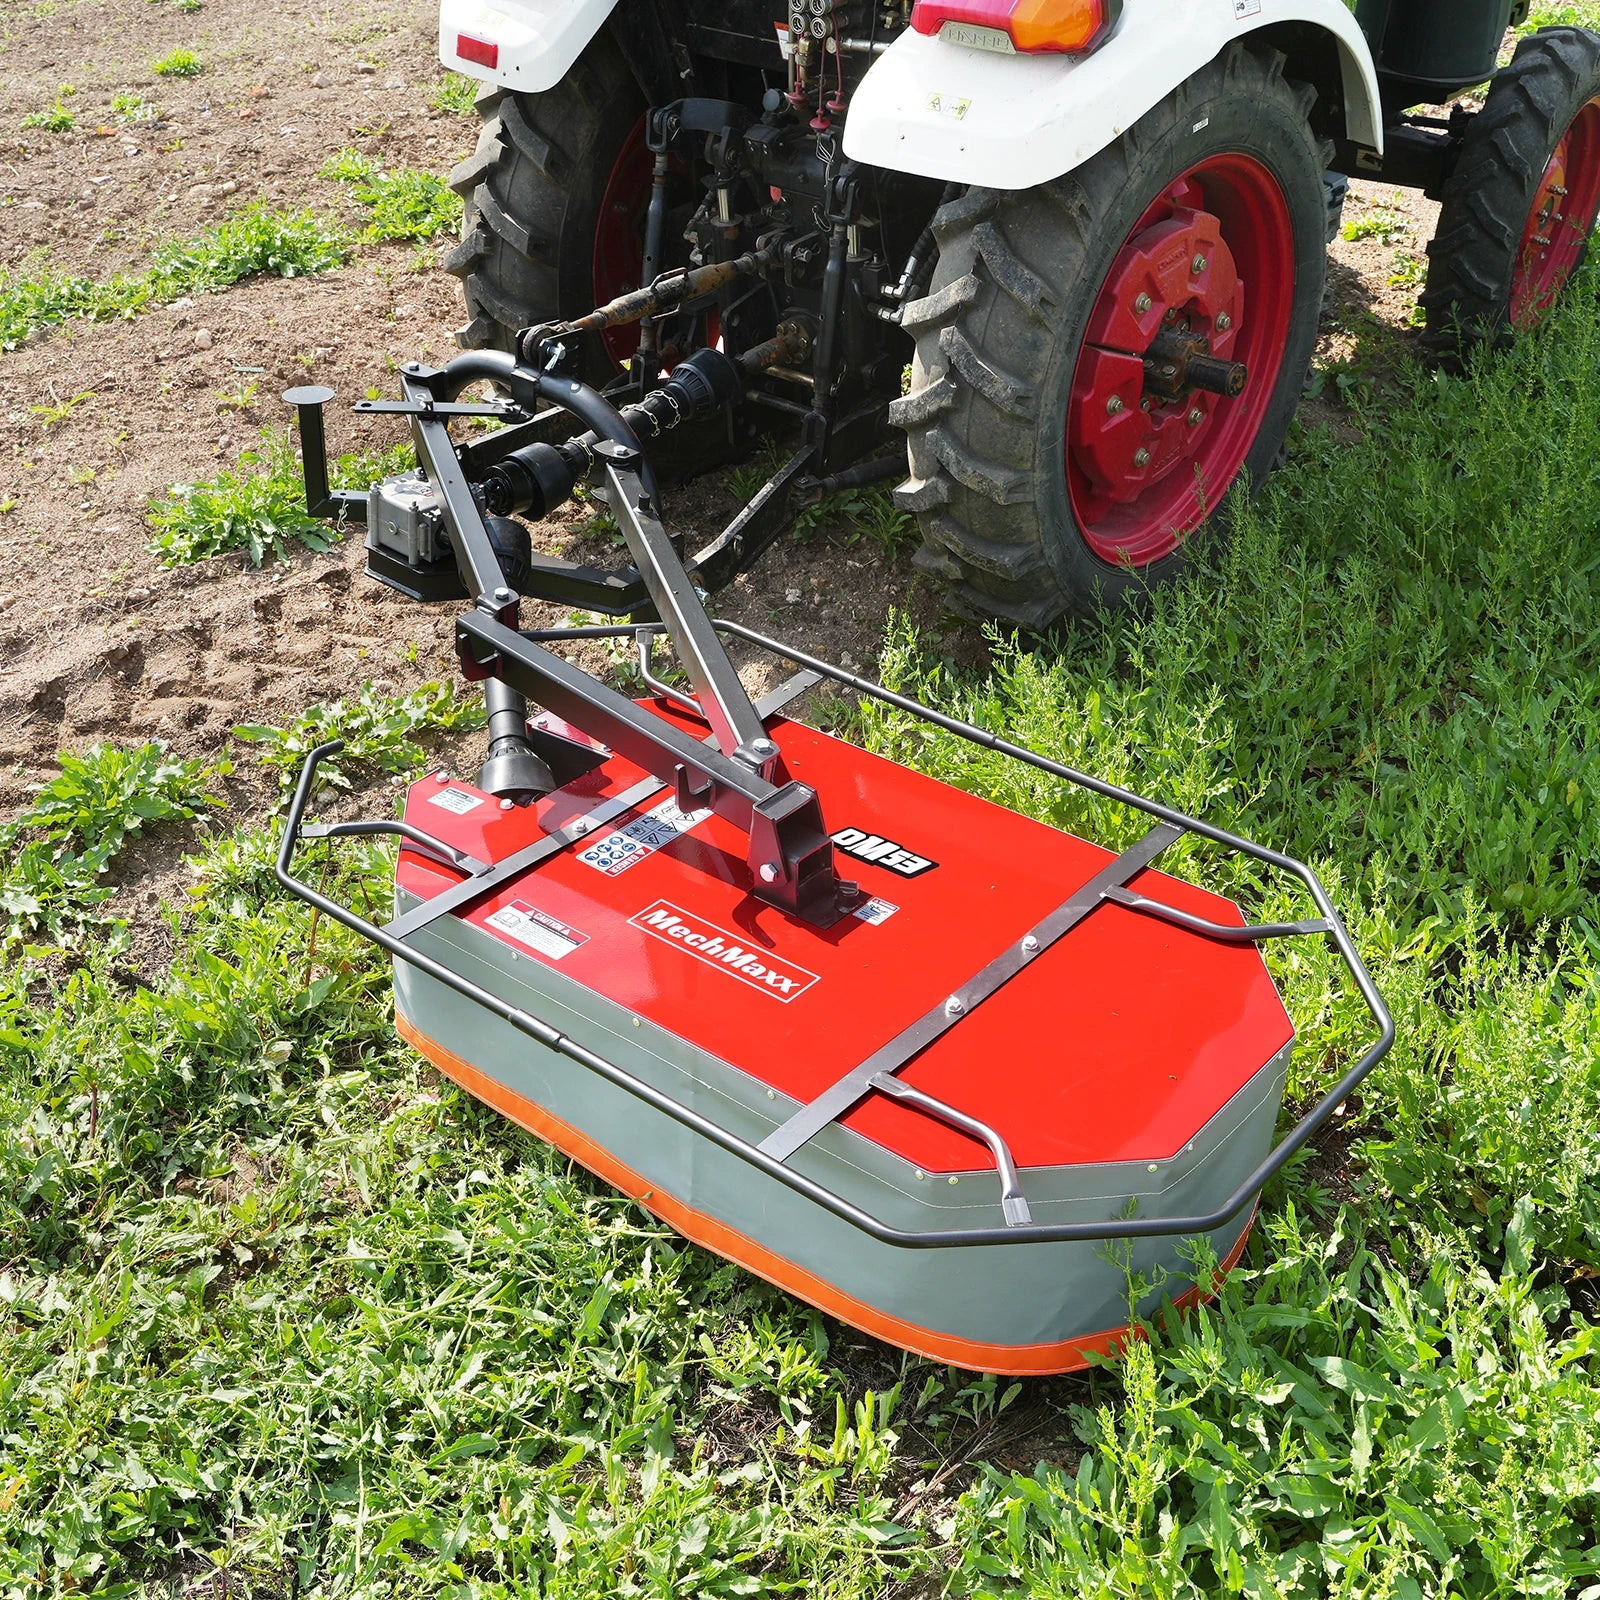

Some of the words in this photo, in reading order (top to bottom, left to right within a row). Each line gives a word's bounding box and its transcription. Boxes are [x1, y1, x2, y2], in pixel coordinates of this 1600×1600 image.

[829, 828, 932, 874] DM53
[533, 912, 566, 931] CAUTION
[640, 909, 800, 993] MechMaxx
